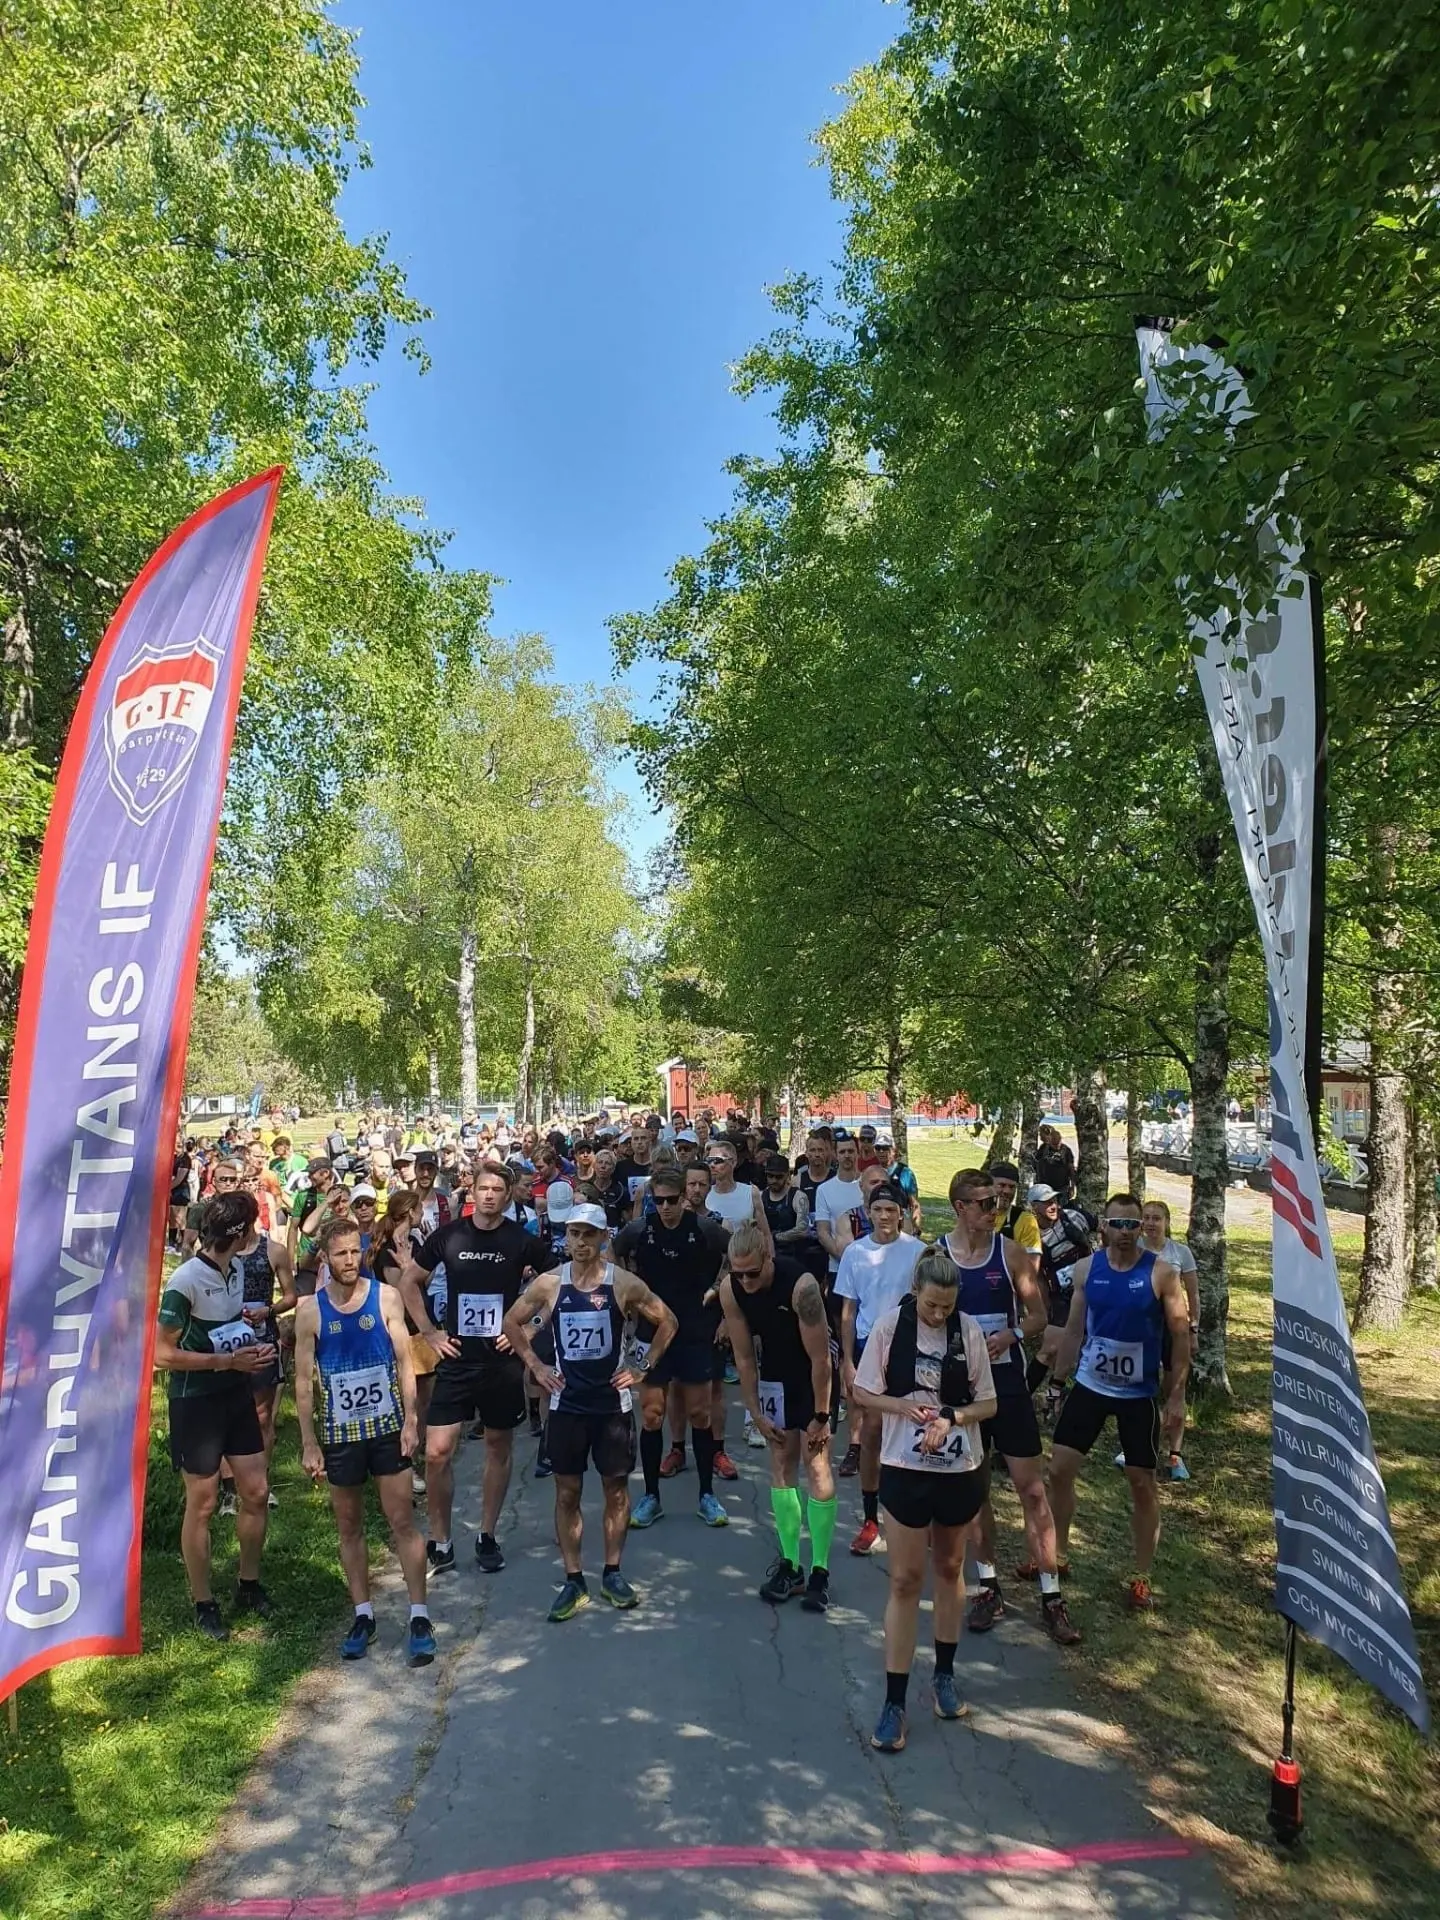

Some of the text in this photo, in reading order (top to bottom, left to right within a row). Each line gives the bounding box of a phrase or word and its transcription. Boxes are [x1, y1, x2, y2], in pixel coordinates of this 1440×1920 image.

[99, 861, 156, 935] IF
[458, 1251, 496, 1261] CRAFT
[464, 1308, 495, 1326] 211
[567, 1326, 605, 1349] 271
[1095, 1352, 1134, 1376] 210
[1273, 1311, 1352, 1376] ÄNGDSKIDOR
[339, 1382, 383, 1411] 325
[760, 1396, 777, 1417] 14
[1273, 1370, 1360, 1436] ORIENTERING
[912, 1428, 963, 1458] 24
[1275, 1425, 1377, 1503] TRAILRUNNING
[1302, 1494, 1369, 1550] LÖPNING
[1312, 1549, 1382, 1612] SWIMRUN
[1288, 1586, 1418, 1702] OCH MYCKET MER
